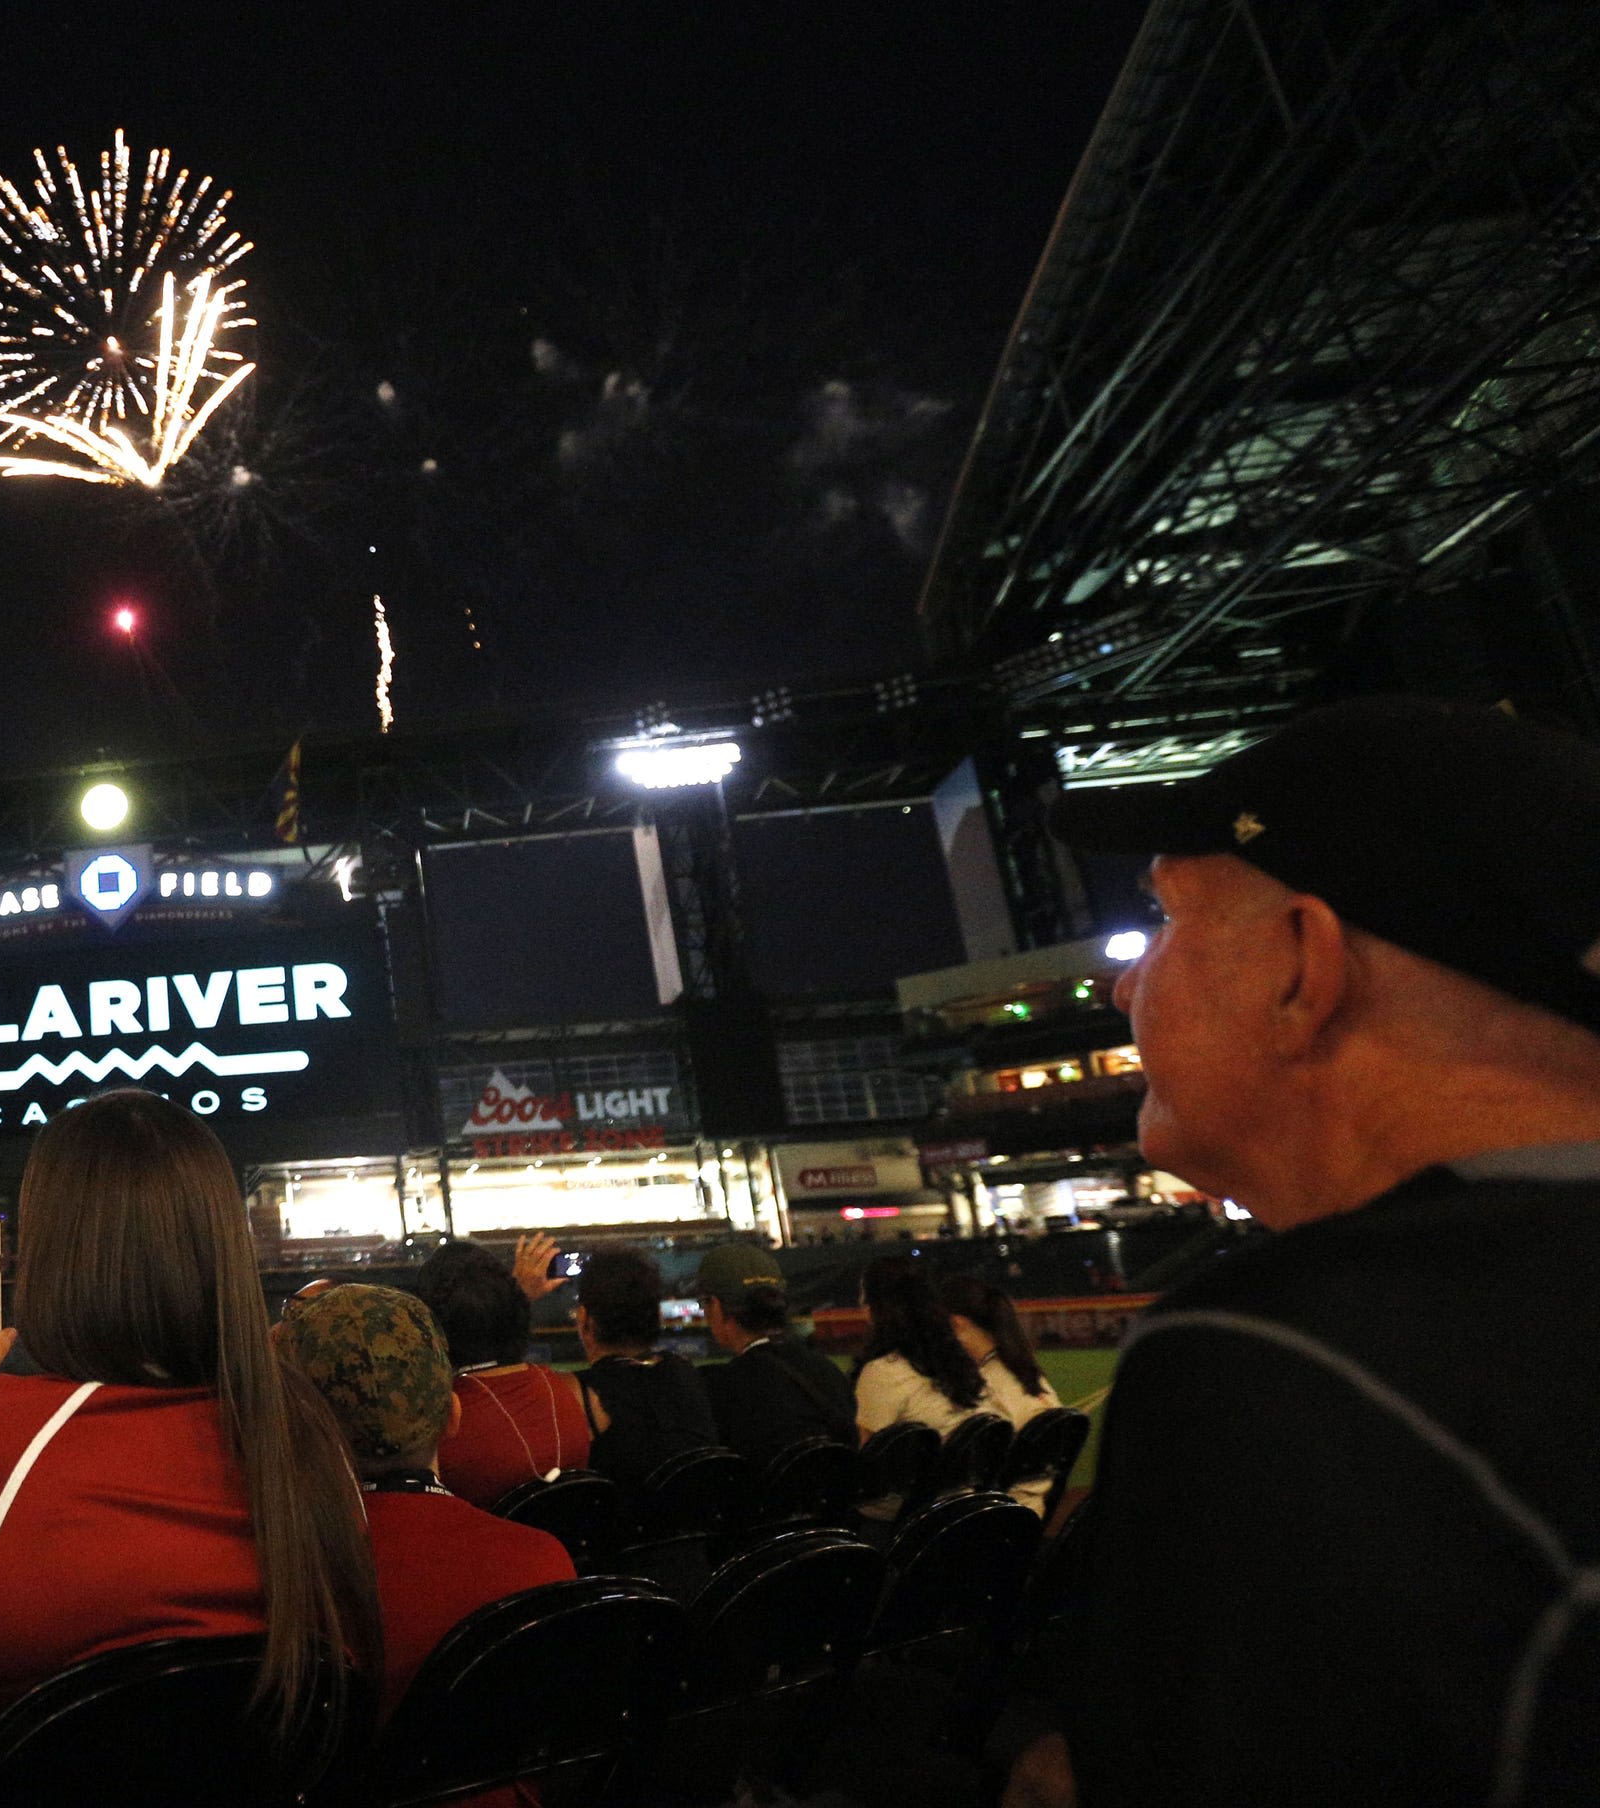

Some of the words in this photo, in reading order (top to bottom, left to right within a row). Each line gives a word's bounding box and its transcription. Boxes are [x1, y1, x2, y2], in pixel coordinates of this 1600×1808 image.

[160, 871, 272, 897] FIELD
[575, 1086, 672, 1121] LIGHT
[471, 1131, 576, 1160] STRIKE
[582, 1126, 666, 1152] ZONE
